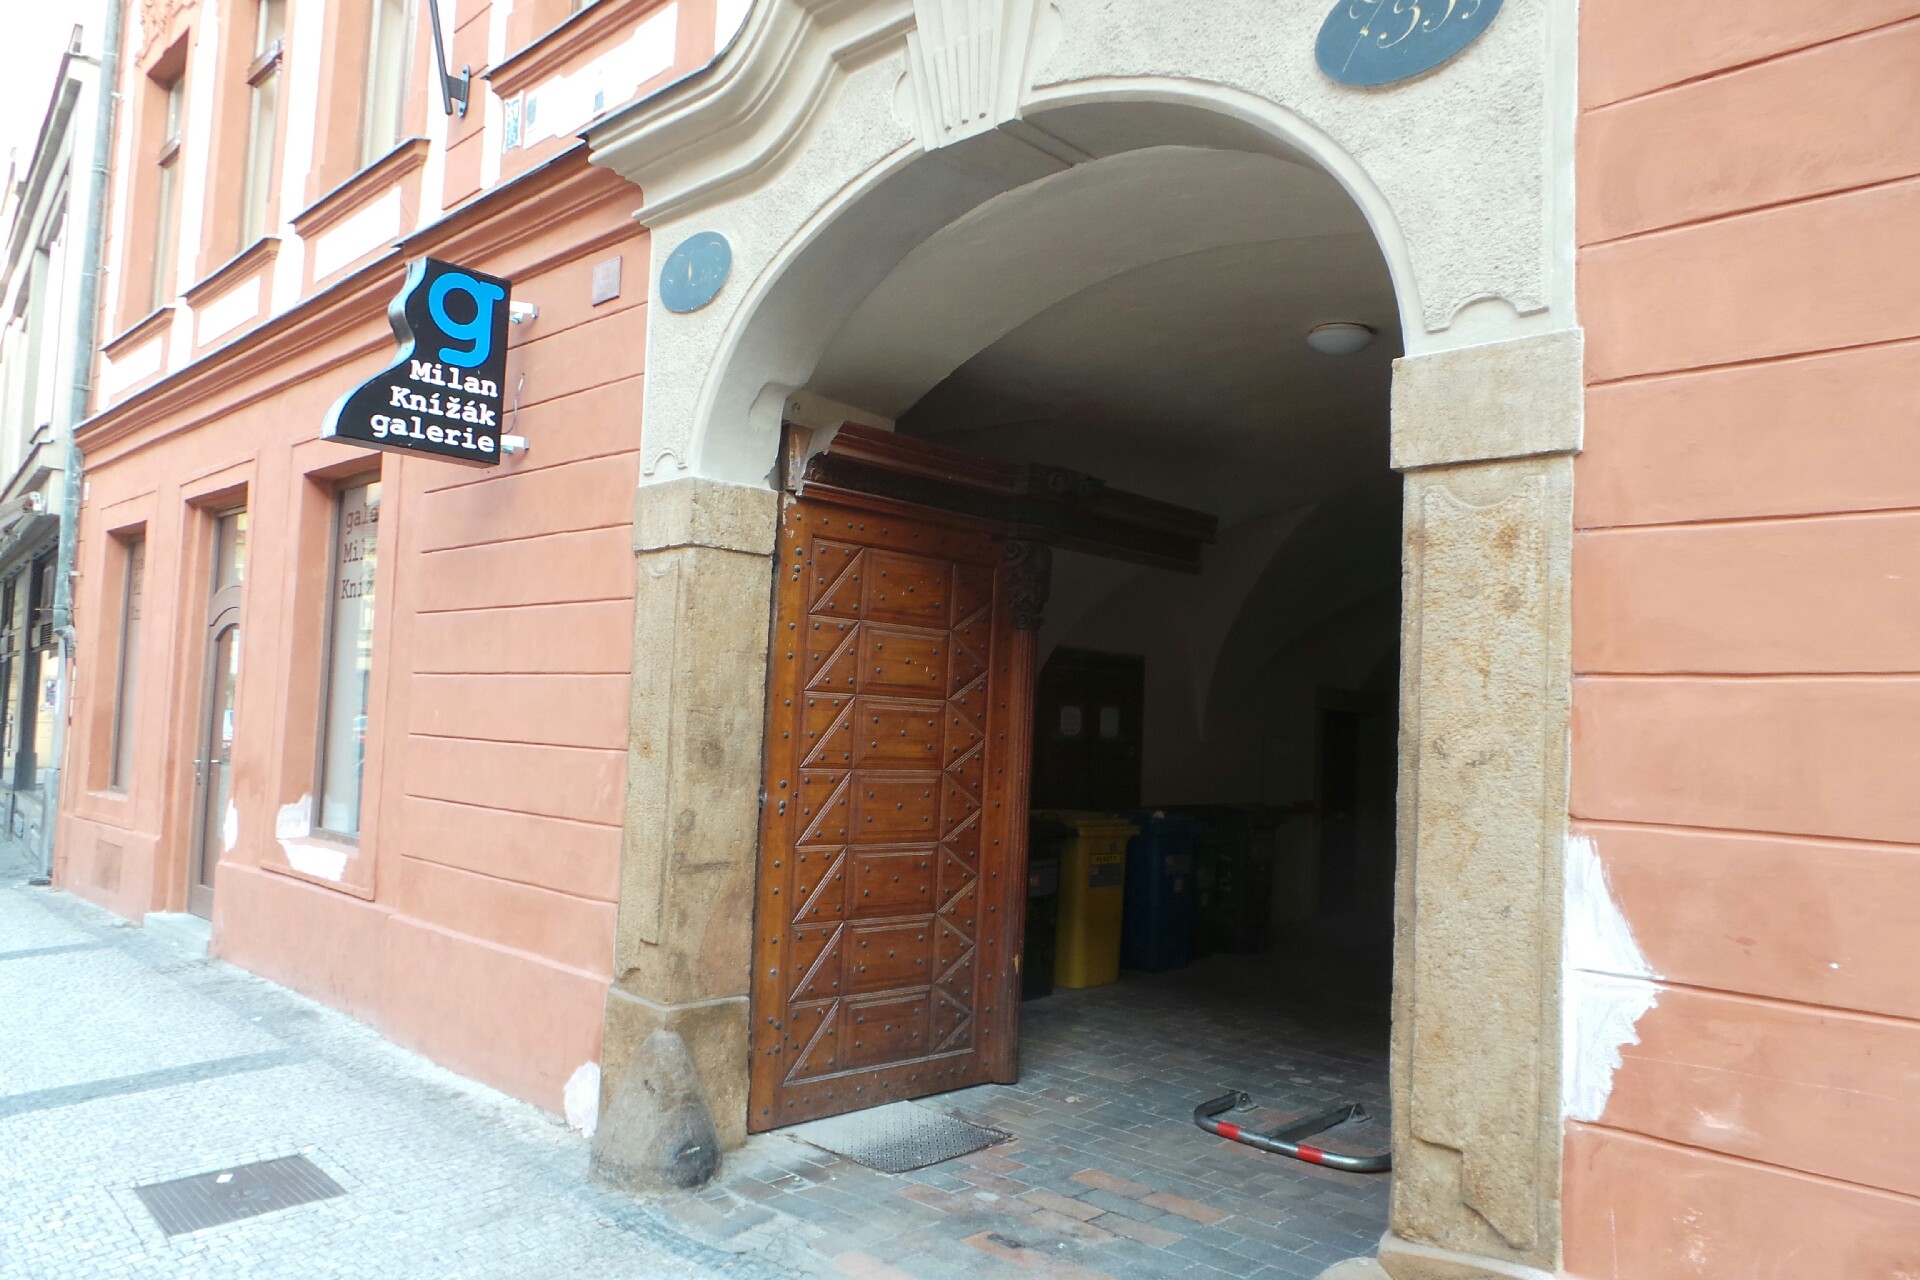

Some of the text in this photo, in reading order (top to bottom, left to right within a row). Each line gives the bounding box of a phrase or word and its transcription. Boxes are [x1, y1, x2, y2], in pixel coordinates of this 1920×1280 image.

[428, 272, 505, 368] g
[409, 359, 498, 398] Milan
[389, 385, 496, 427] Knížák
[370, 414, 495, 453] galerie
